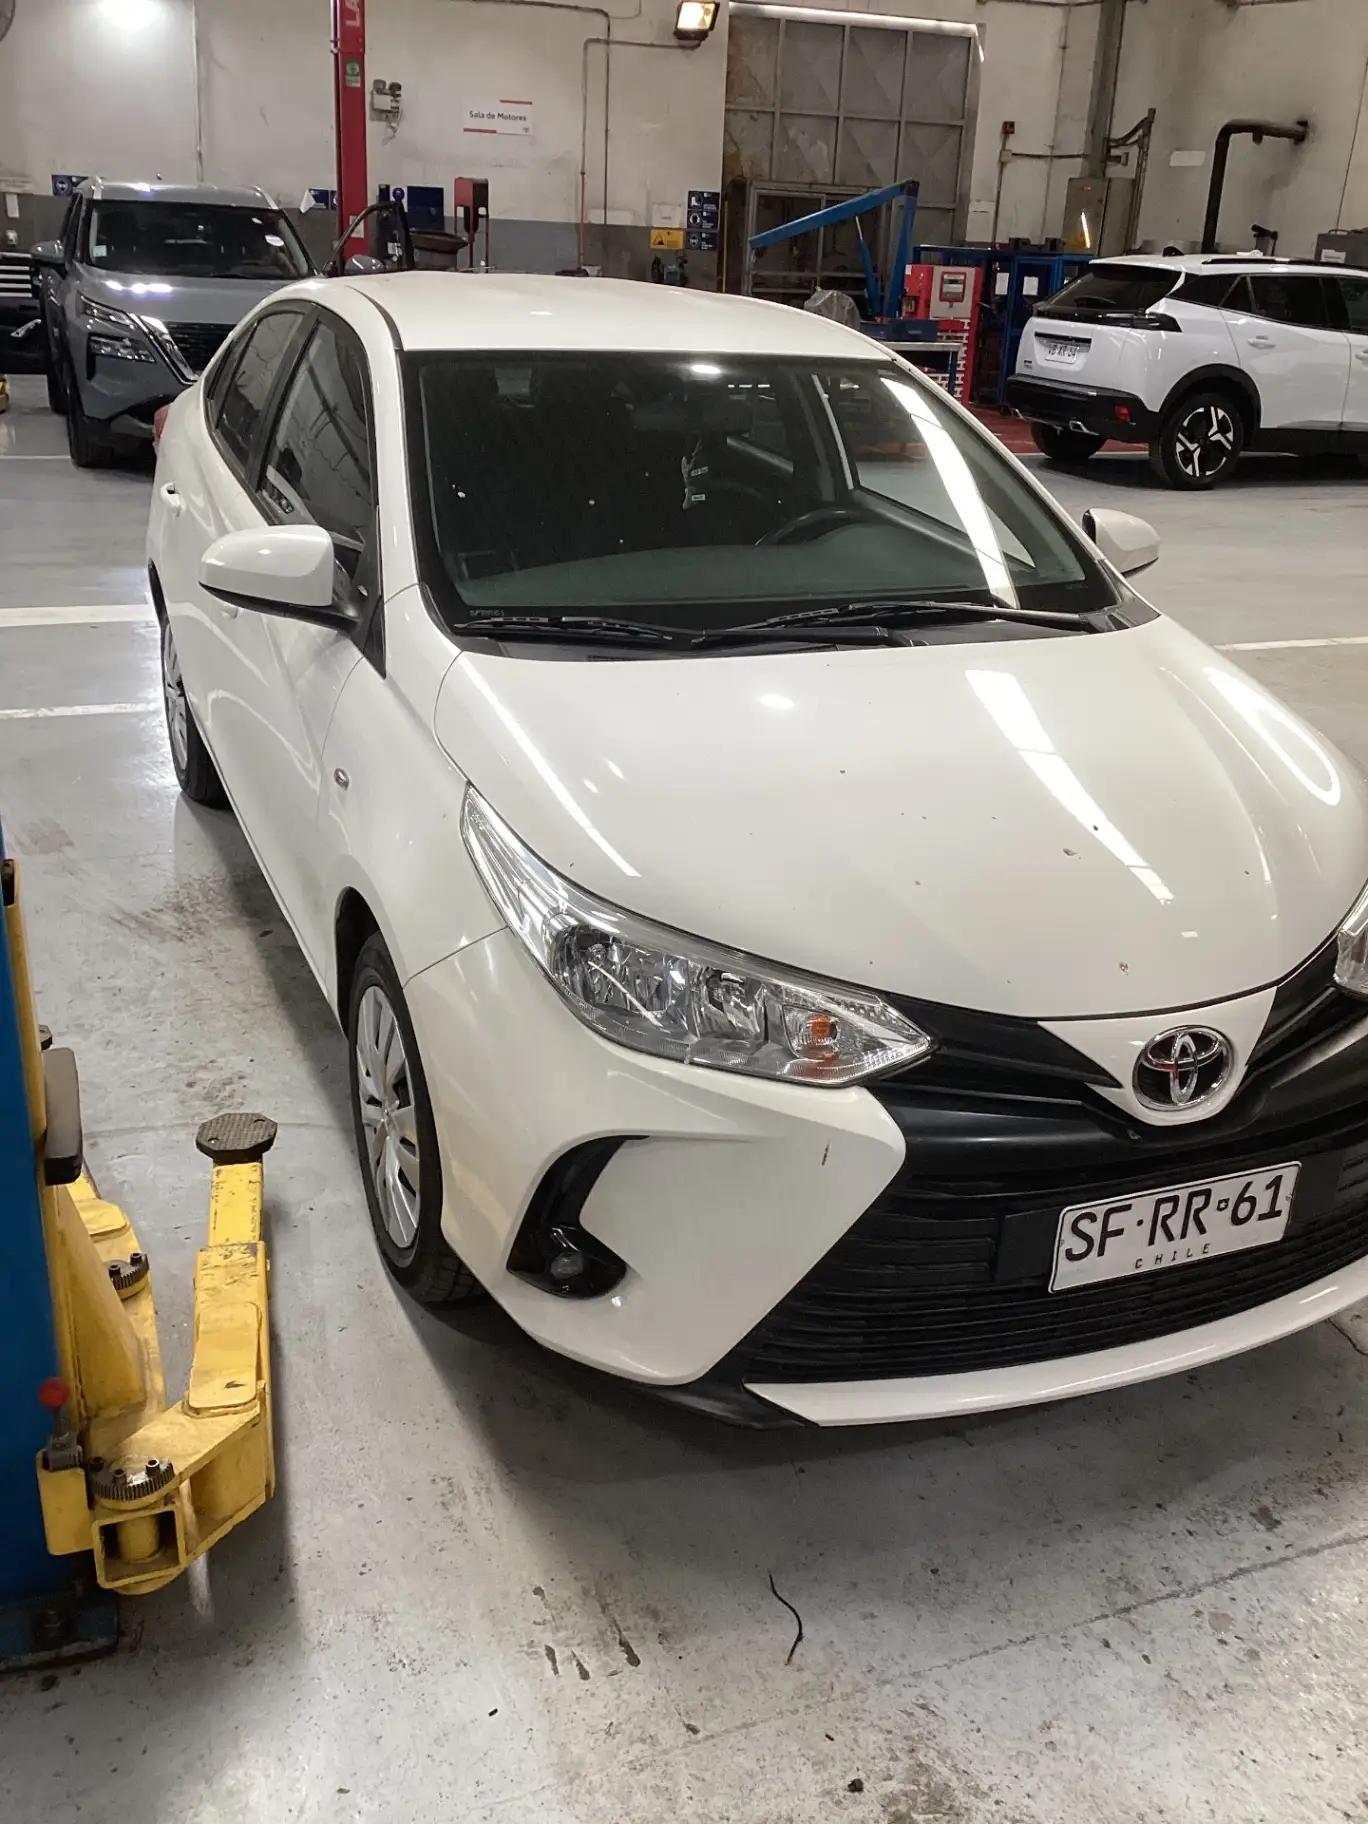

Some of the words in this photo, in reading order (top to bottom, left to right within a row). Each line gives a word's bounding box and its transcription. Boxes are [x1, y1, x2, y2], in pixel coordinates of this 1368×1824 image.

[469, 110, 485, 119] Sala
[486, 112, 496, 120] de
[497, 112, 527, 121] Motores
[1134, 1243, 1211, 1269] CHILE
